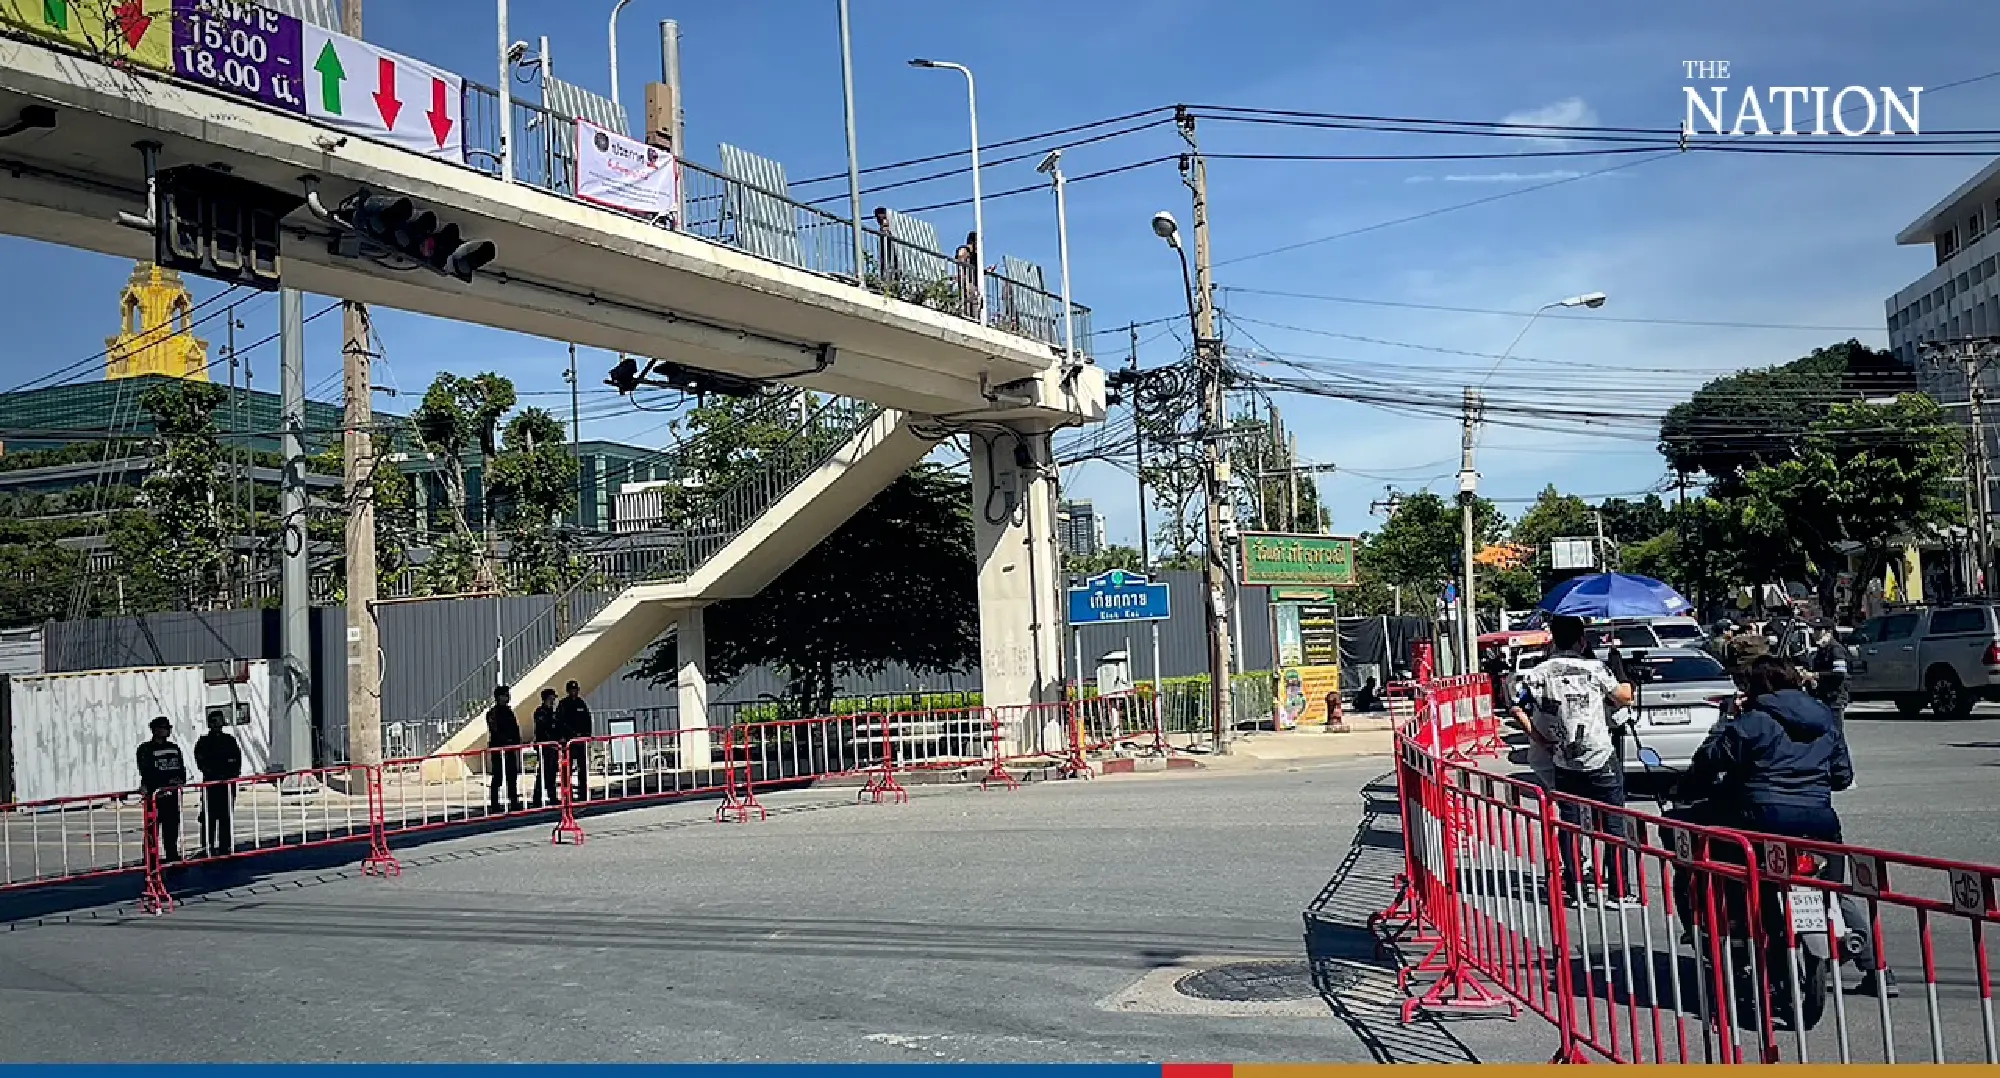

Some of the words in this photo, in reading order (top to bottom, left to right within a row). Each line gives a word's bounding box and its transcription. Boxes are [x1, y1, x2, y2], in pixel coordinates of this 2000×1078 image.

[188, 14, 267, 63] 15.00
[181, 45, 261, 92] 18.00
[1794, 918, 1824, 928] 232
